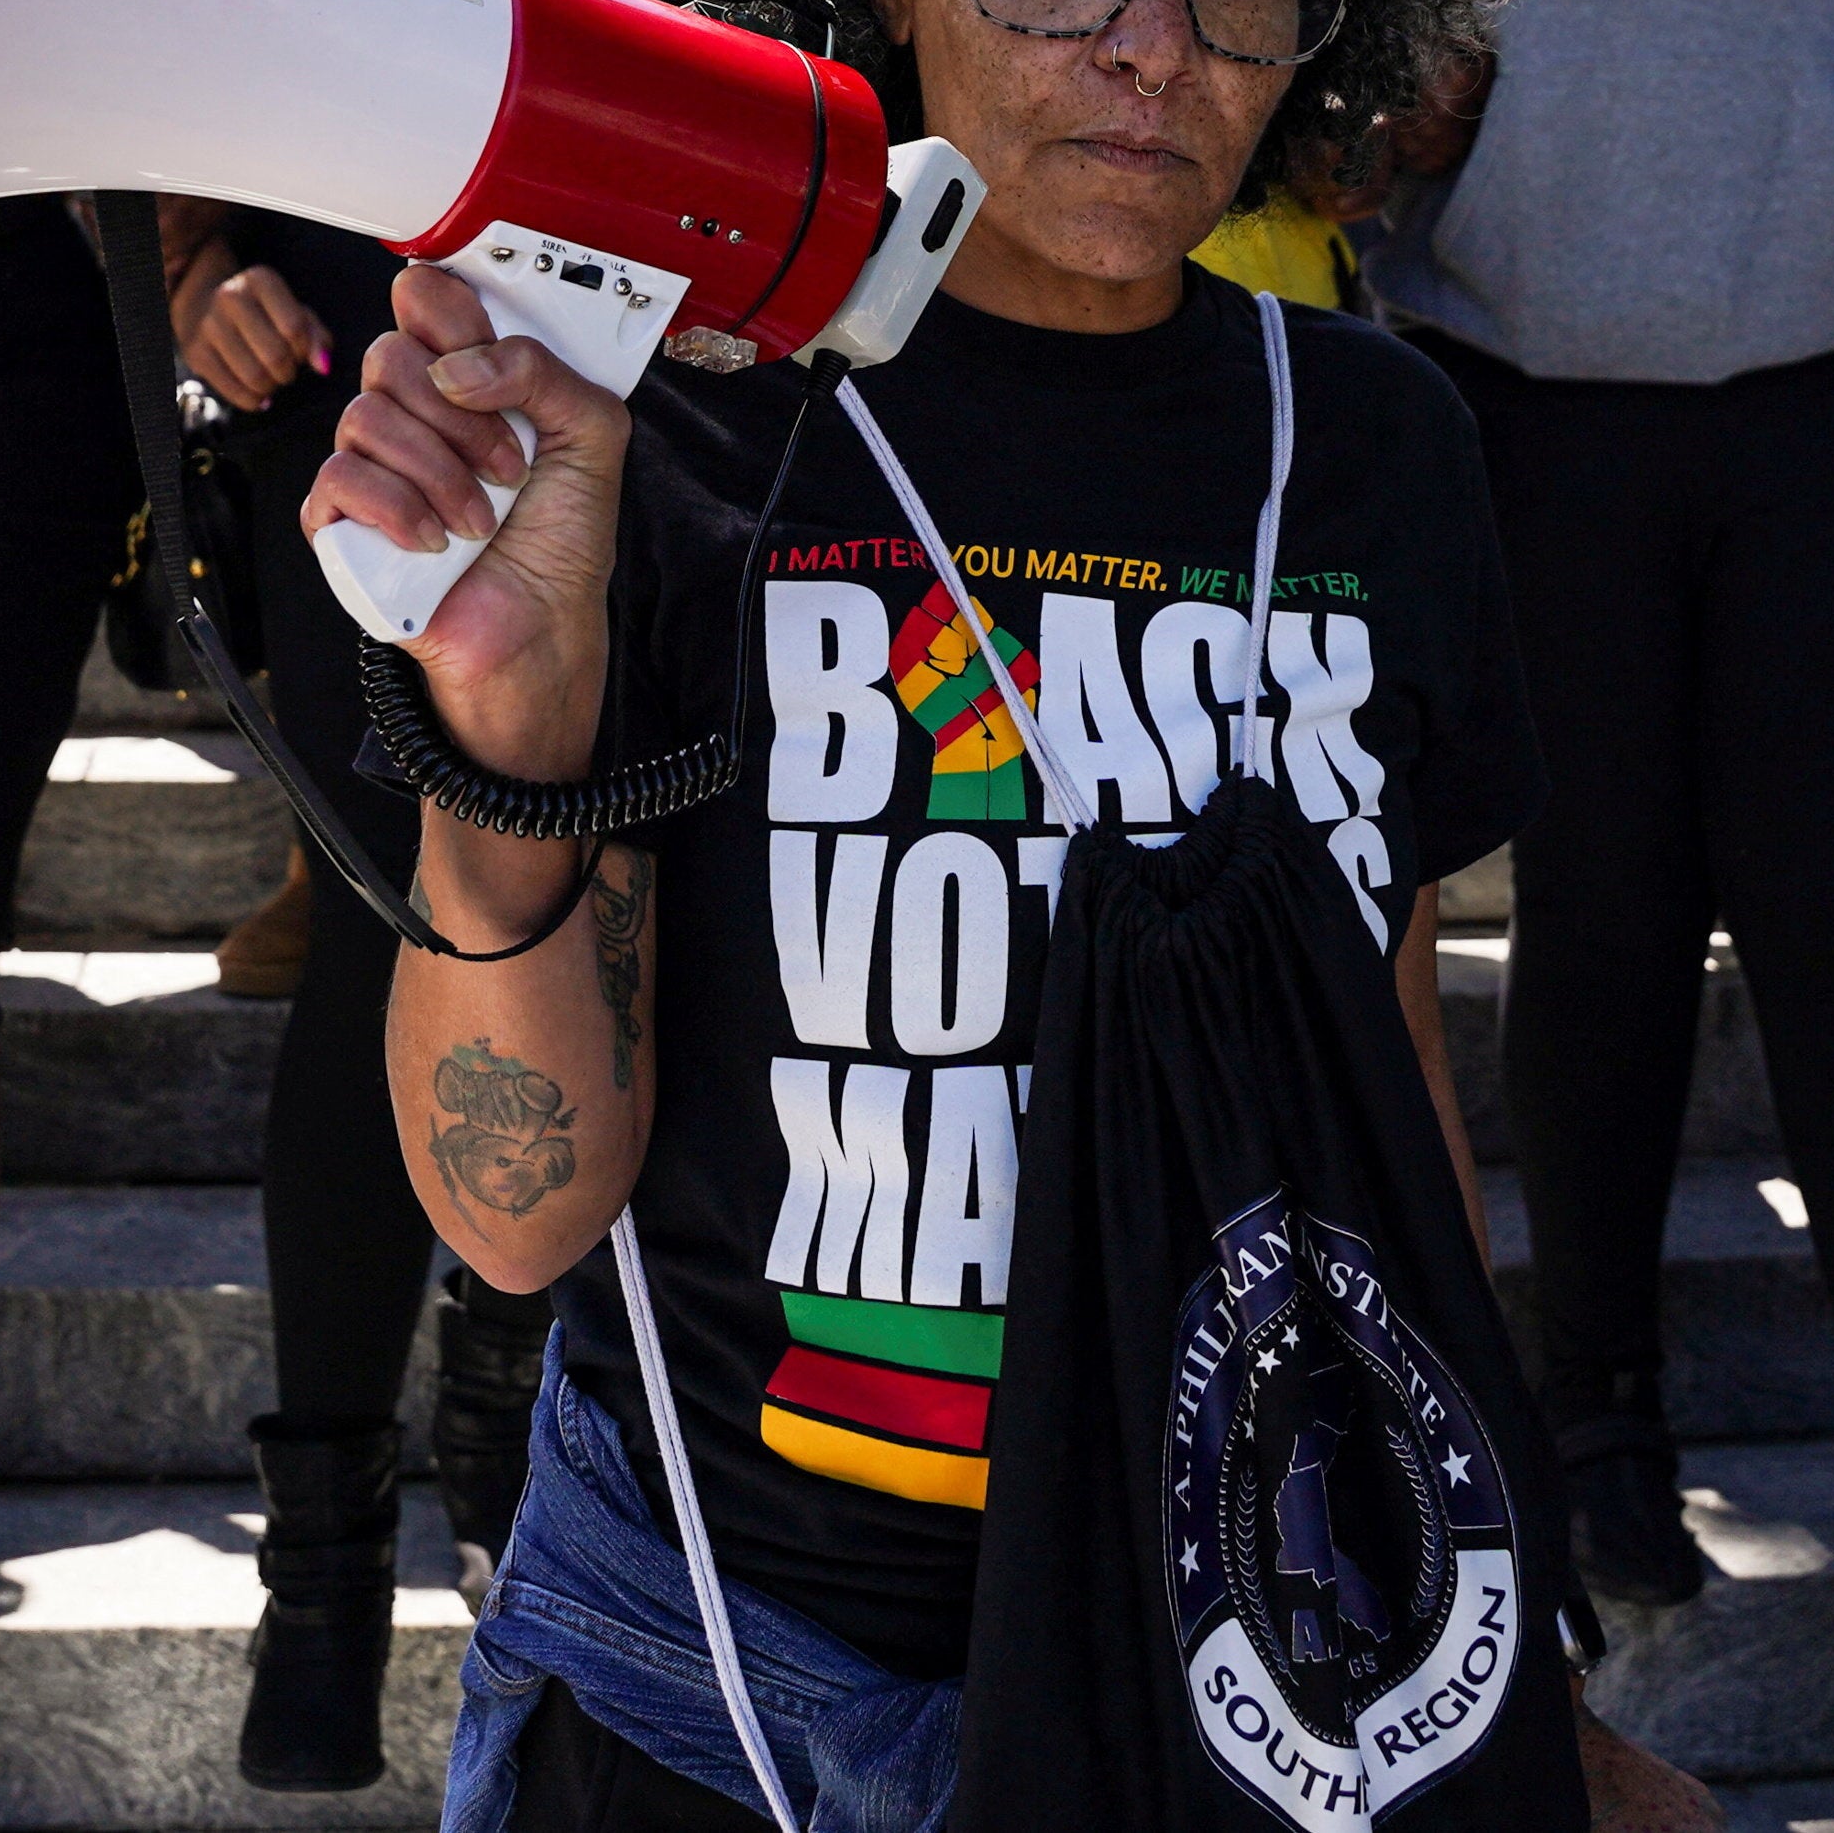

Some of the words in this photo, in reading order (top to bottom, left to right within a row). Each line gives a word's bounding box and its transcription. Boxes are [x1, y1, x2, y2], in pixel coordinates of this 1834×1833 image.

[768, 550, 778, 574] I
[1024, 548, 1168, 593] MATTER.
[1179, 565, 1231, 600] WE
[765, 579, 1386, 825] BACK
[1175, 1292, 1240, 1450] PHILI
[1203, 1664, 1372, 1817] SOUTH
[1372, 1585, 1507, 1768] REGION
